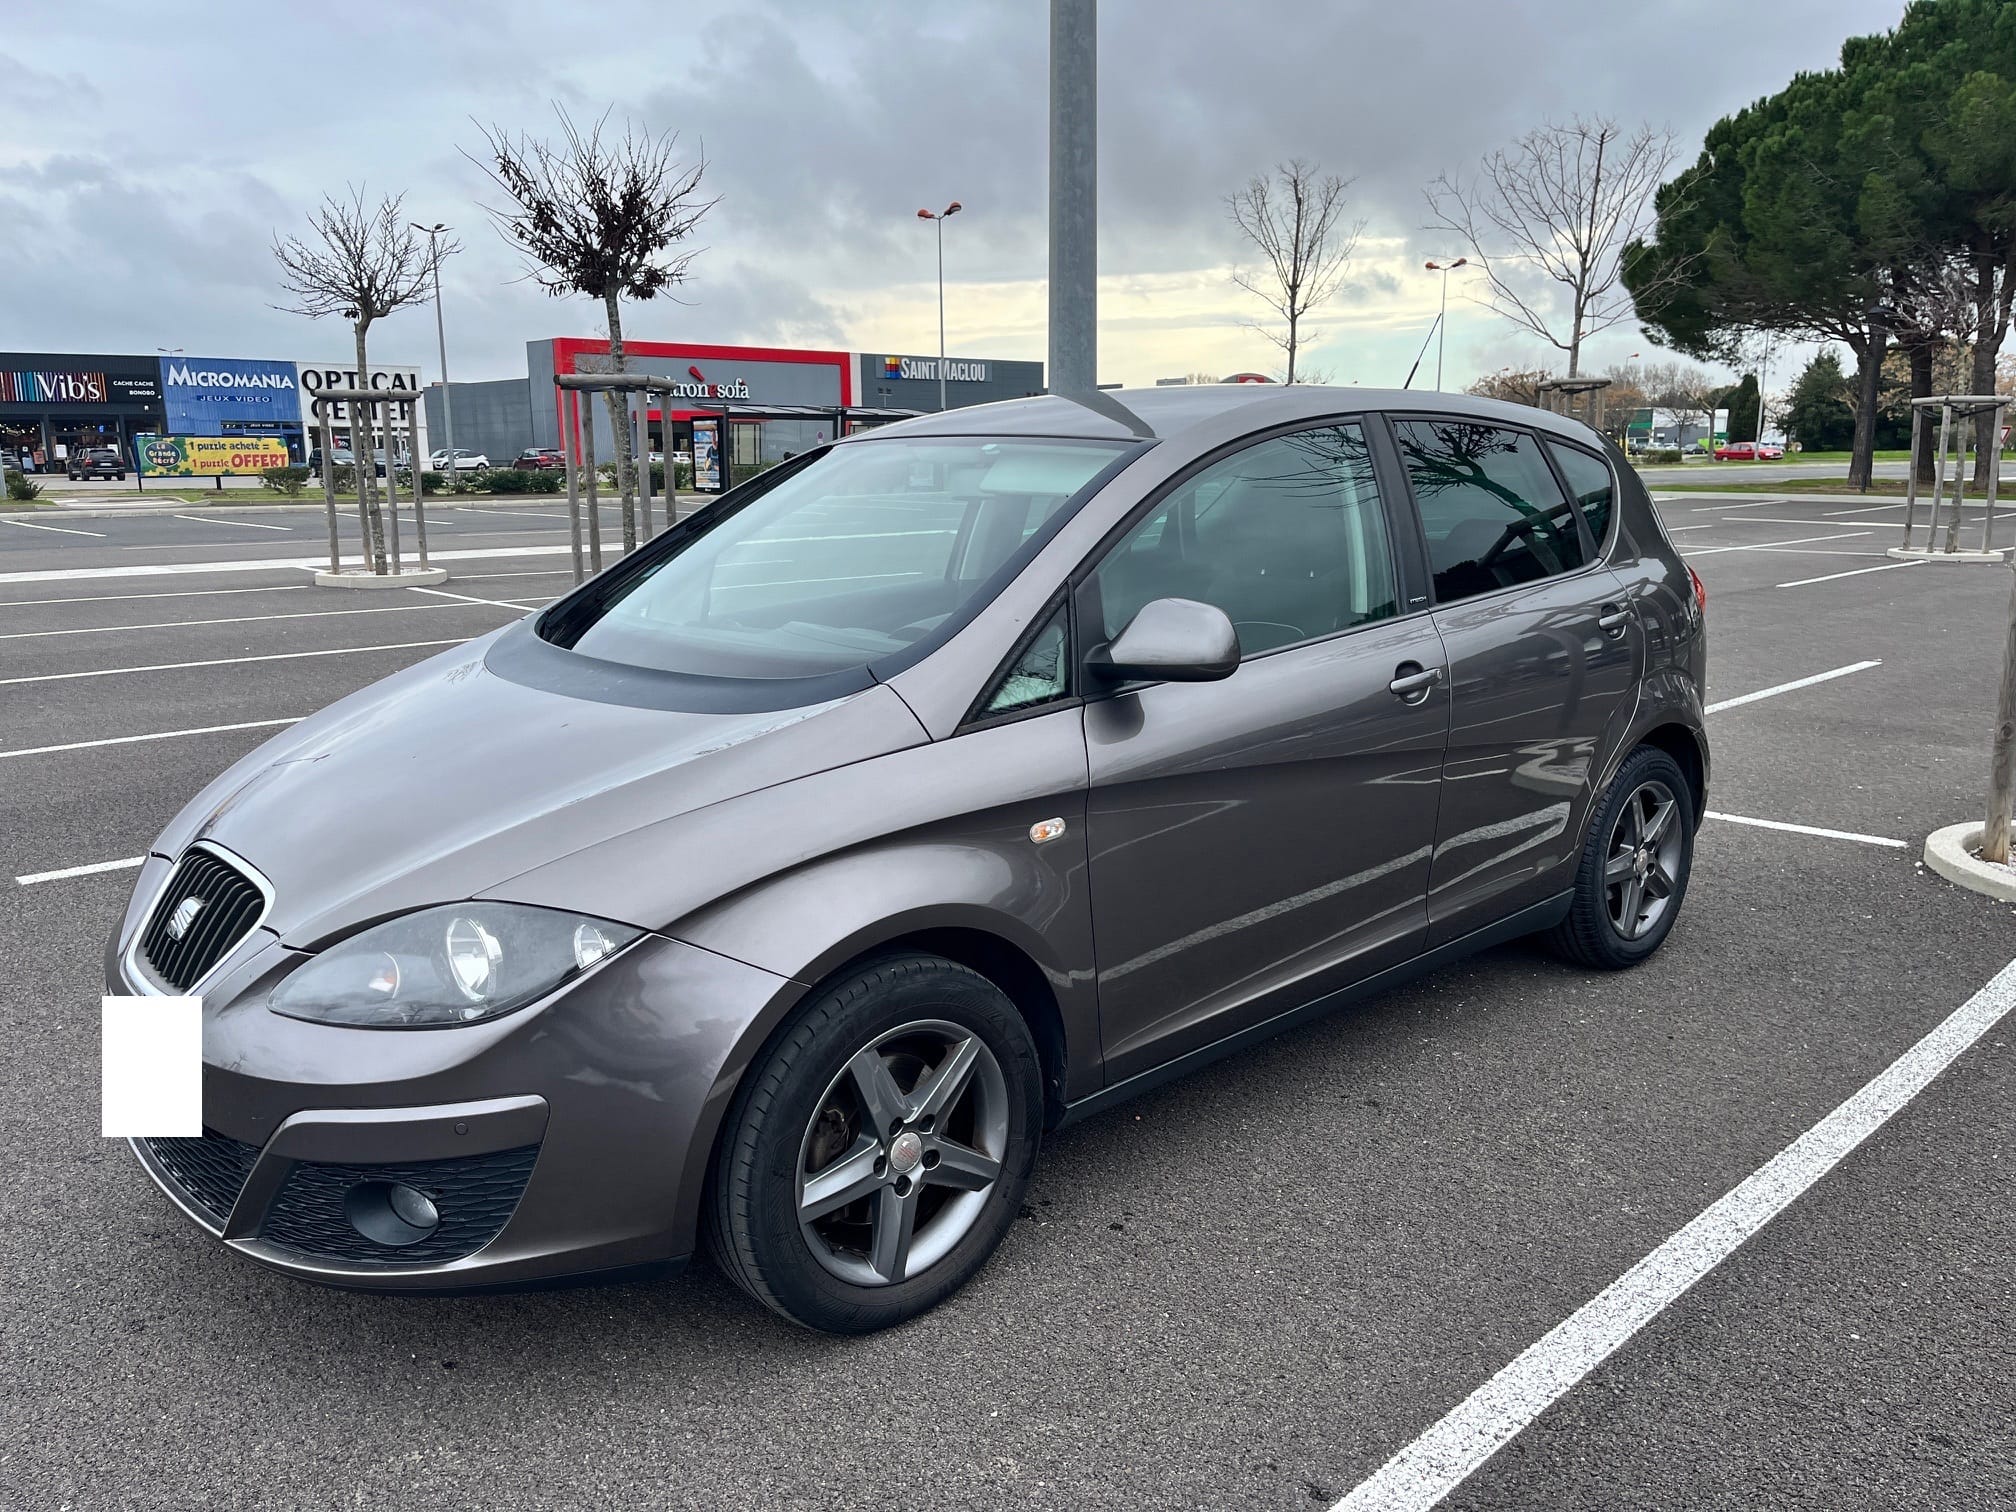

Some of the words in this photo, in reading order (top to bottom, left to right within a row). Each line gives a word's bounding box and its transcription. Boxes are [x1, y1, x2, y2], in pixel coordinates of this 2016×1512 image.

[167, 364, 294, 389] MICROMANIA
[301, 369, 418, 392] OPTCAL
[900, 357, 936, 379] SAINT
[938, 359, 986, 382] MACLOU
[36, 374, 101, 399] Vib's
[311, 399, 409, 420] CETR
[197, 441, 226, 454] puzzle
[200, 458, 230, 470] puzzle
[231, 453, 287, 469] OFFERT
